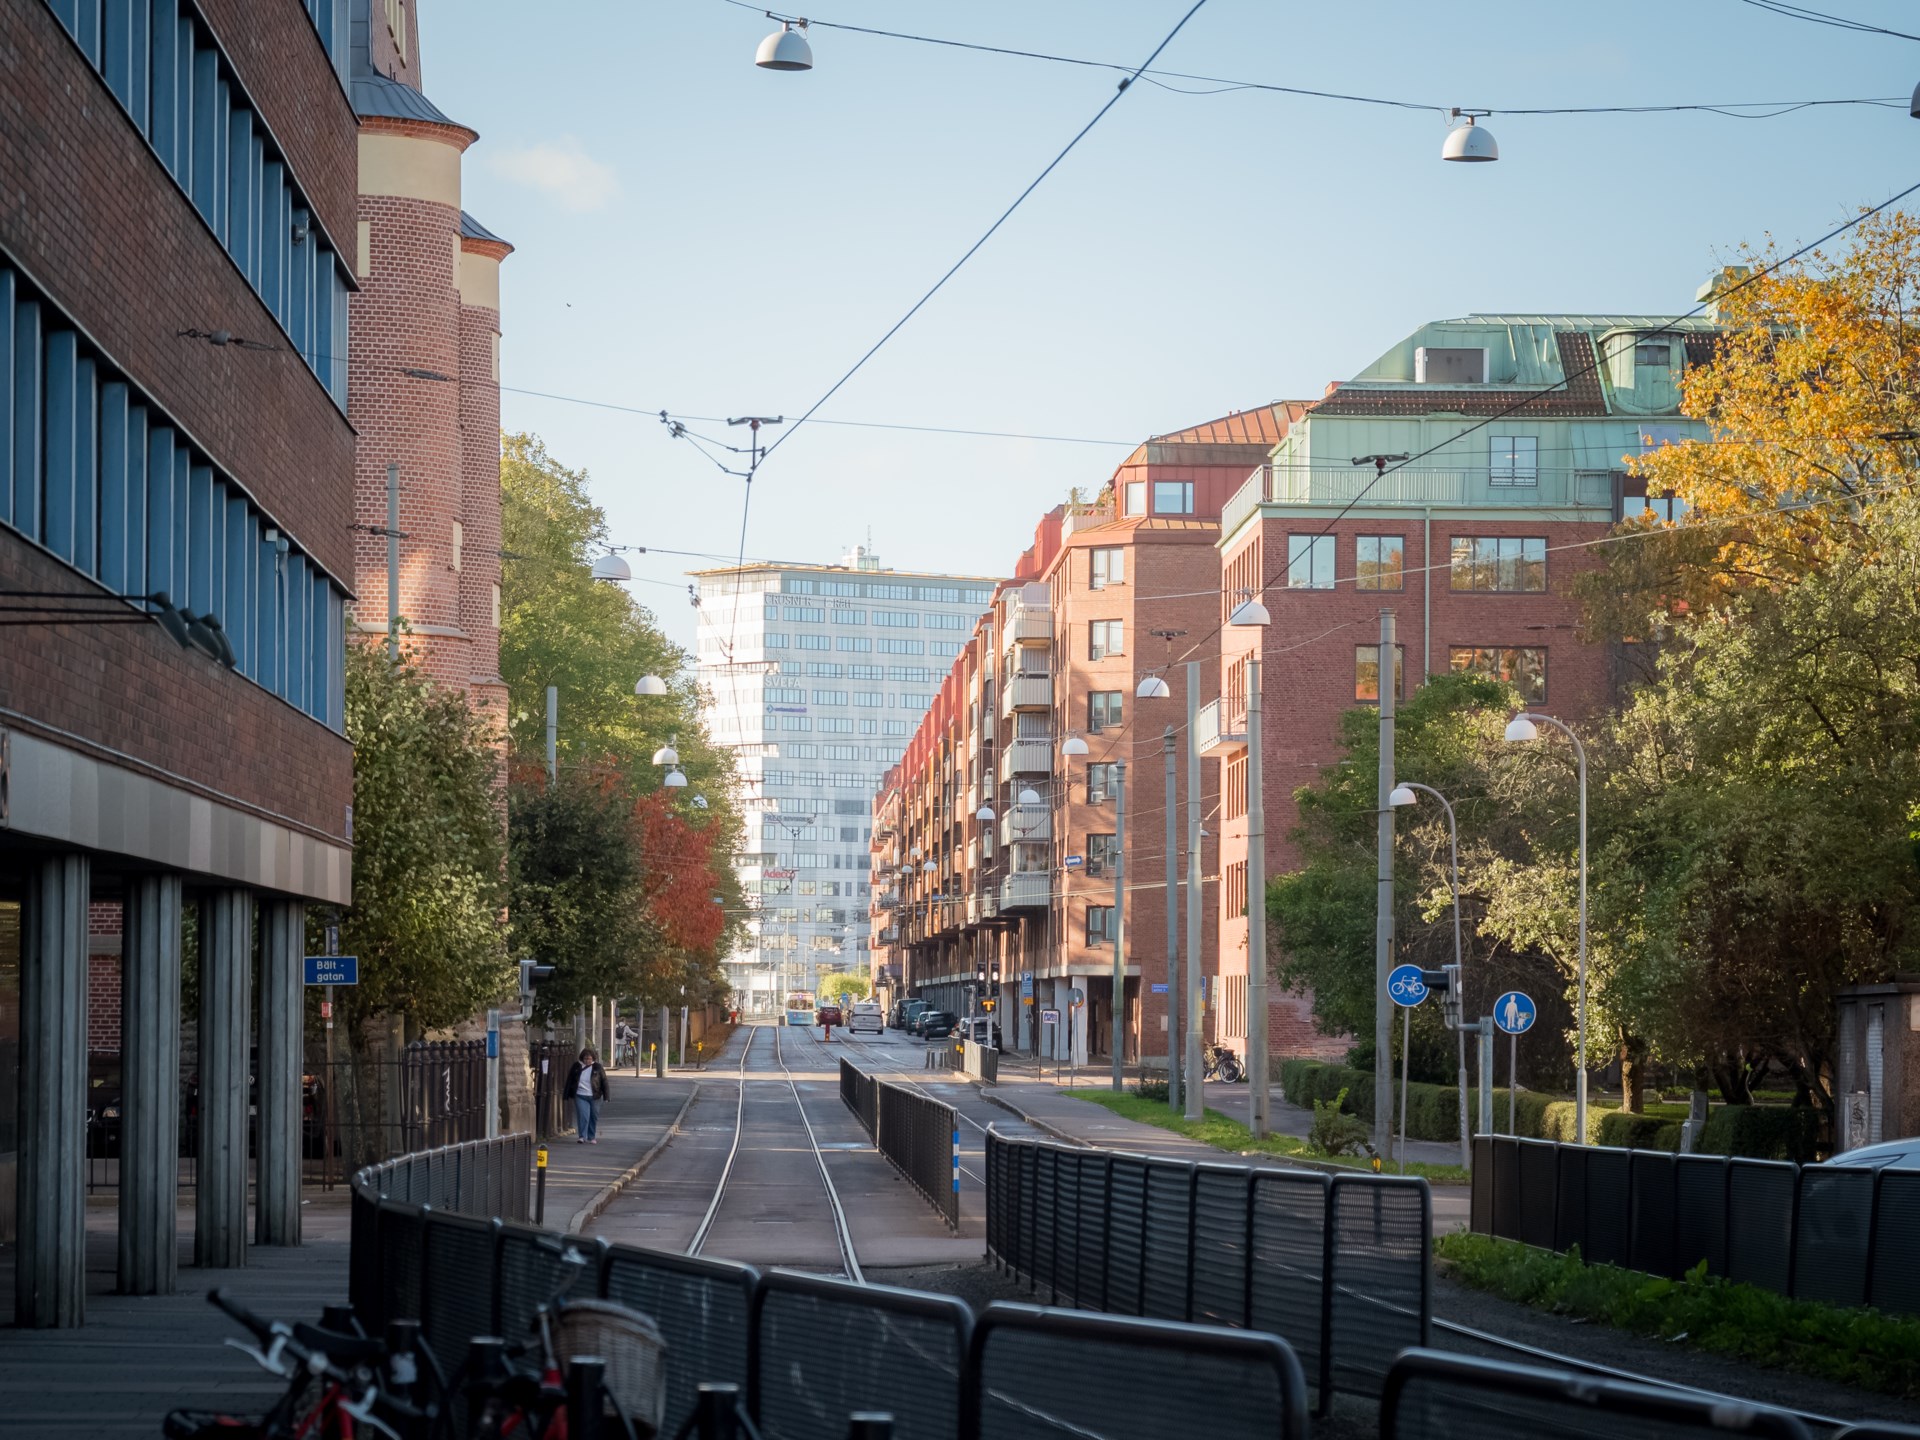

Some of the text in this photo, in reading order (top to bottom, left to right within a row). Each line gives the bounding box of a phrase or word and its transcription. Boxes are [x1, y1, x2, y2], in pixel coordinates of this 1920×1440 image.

[764, 677, 801, 688] SVEFA
[316, 972, 345, 983] gatan
[1024, 973, 1031, 982] P
